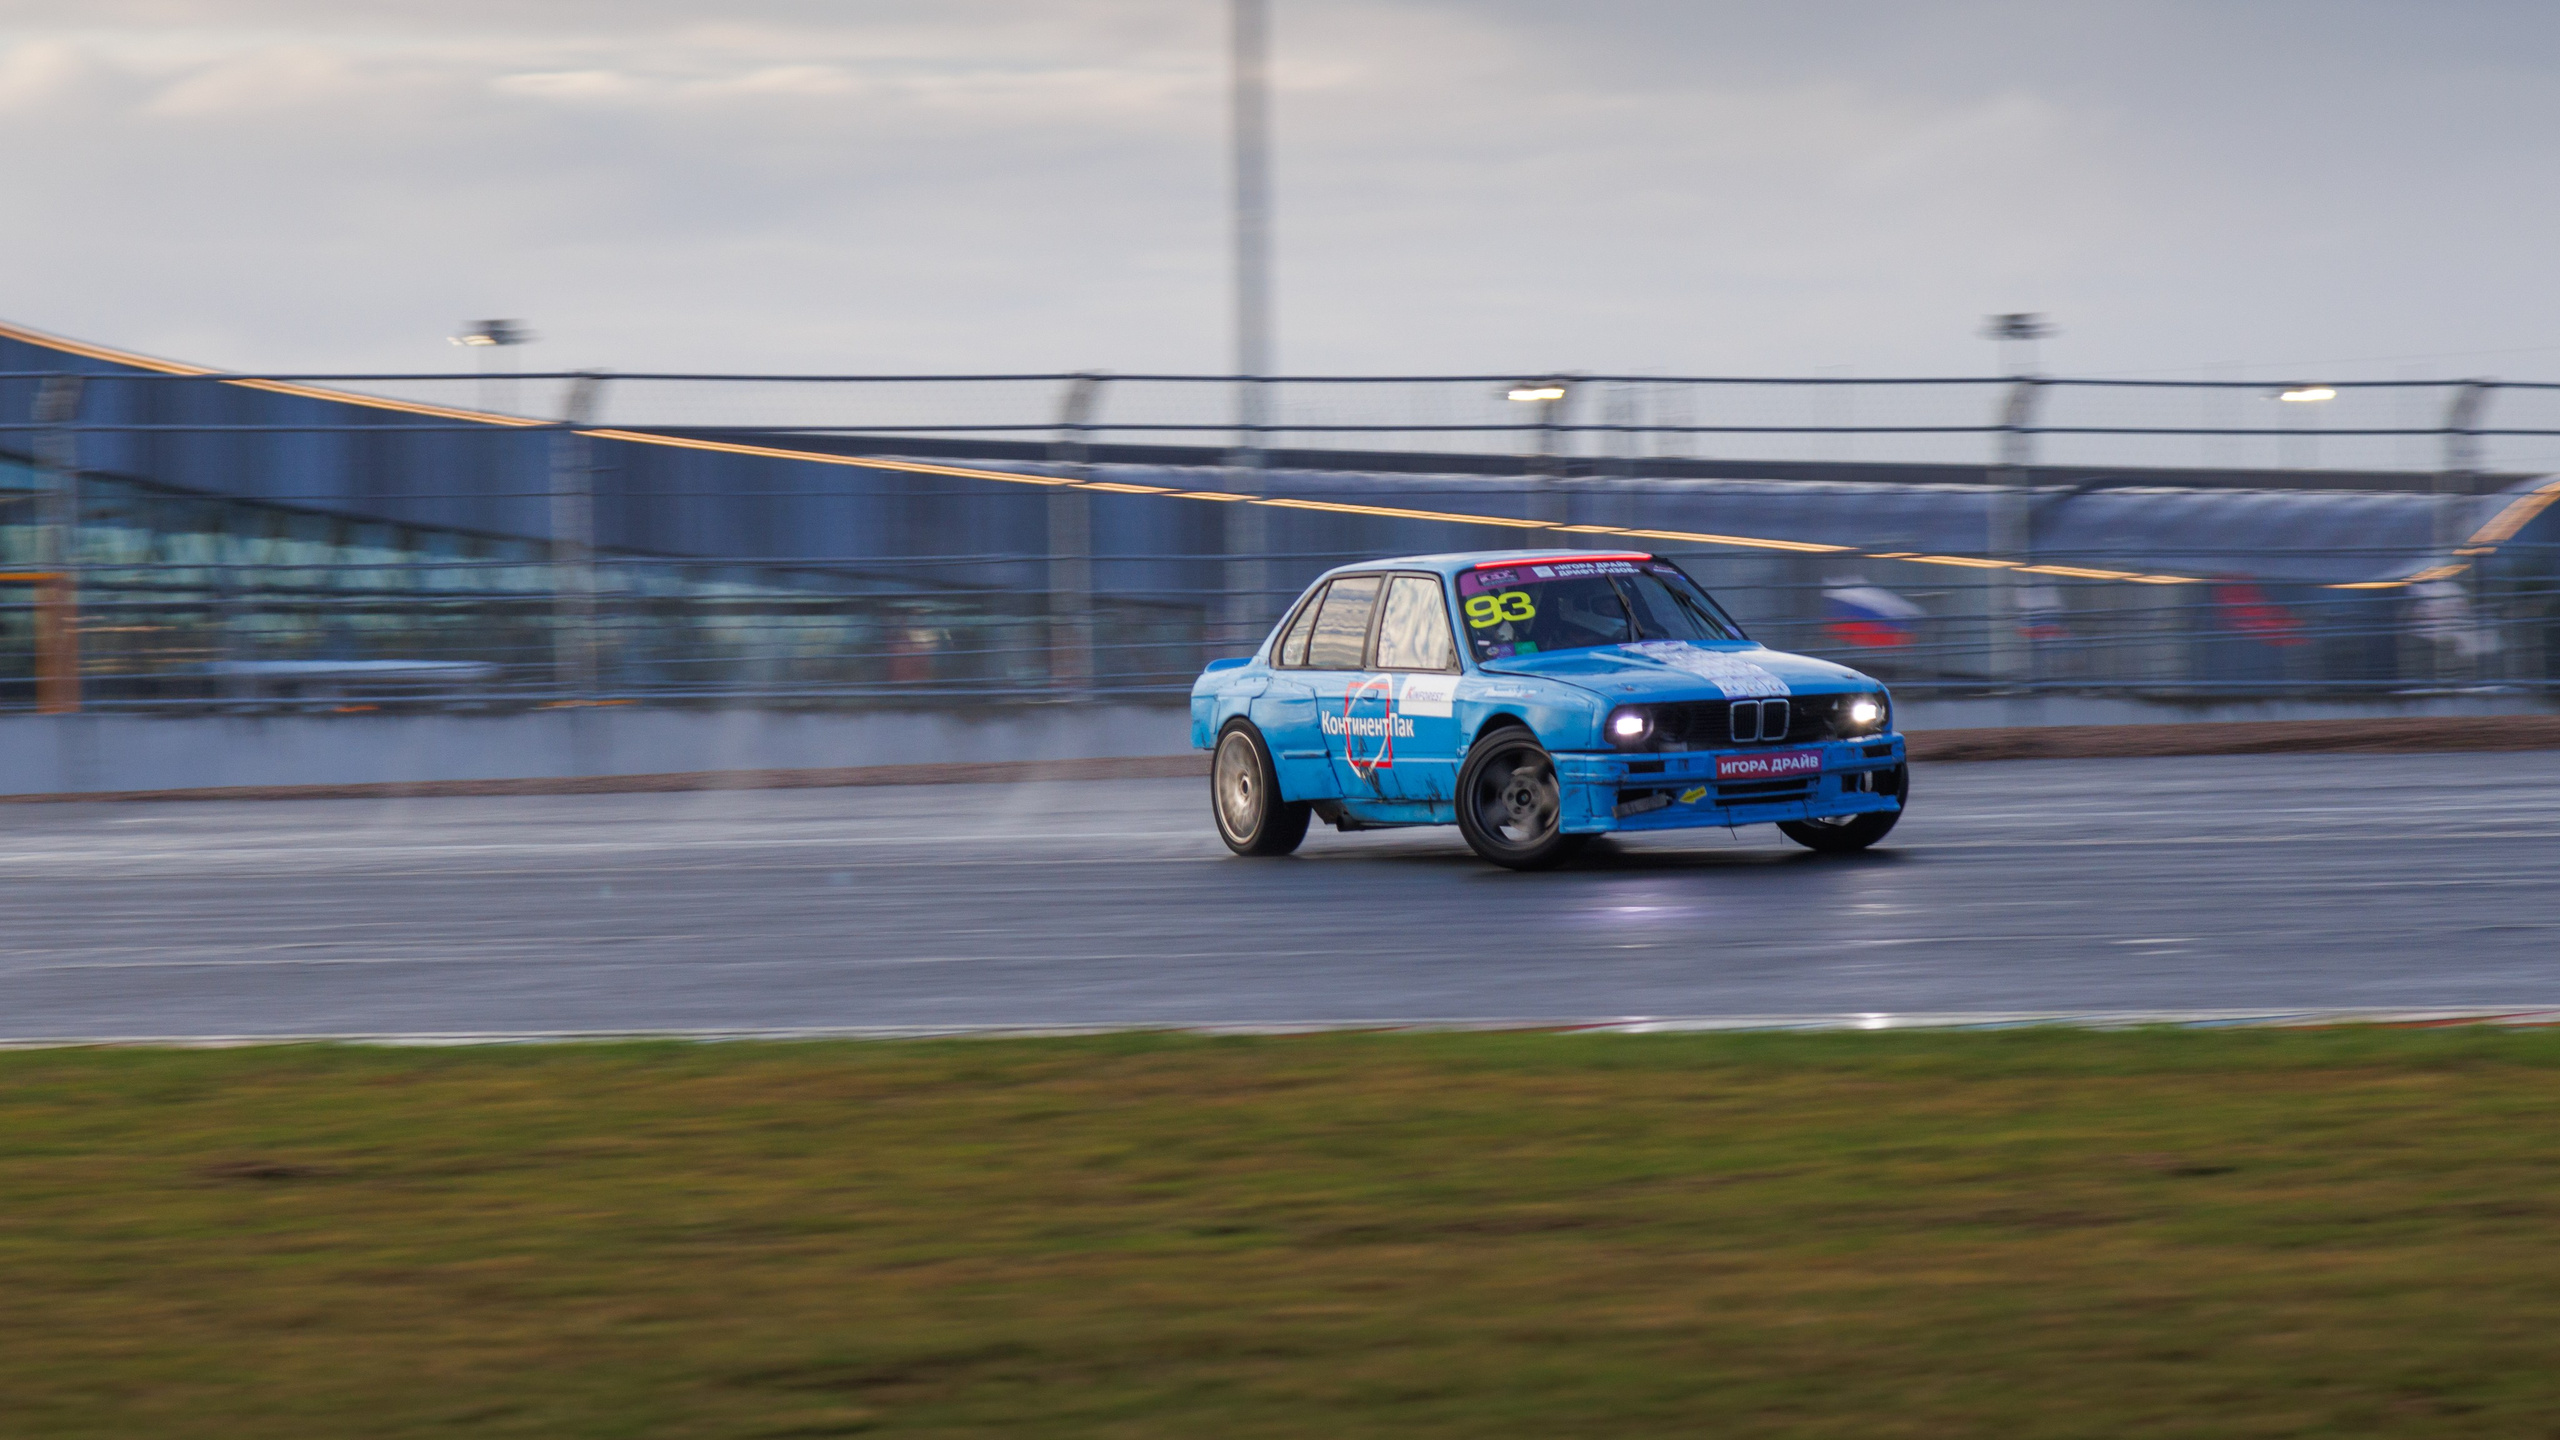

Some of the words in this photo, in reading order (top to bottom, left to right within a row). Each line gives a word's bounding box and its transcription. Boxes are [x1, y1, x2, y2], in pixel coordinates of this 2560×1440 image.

[1595, 561, 1632, 569] ДРАЙВ
[1465, 591, 1536, 629] 93
[1321, 710, 1415, 737] КонтинентПак
[1721, 759, 1769, 774] ИГОРА
[1771, 753, 1819, 773] ДРАЙВ
